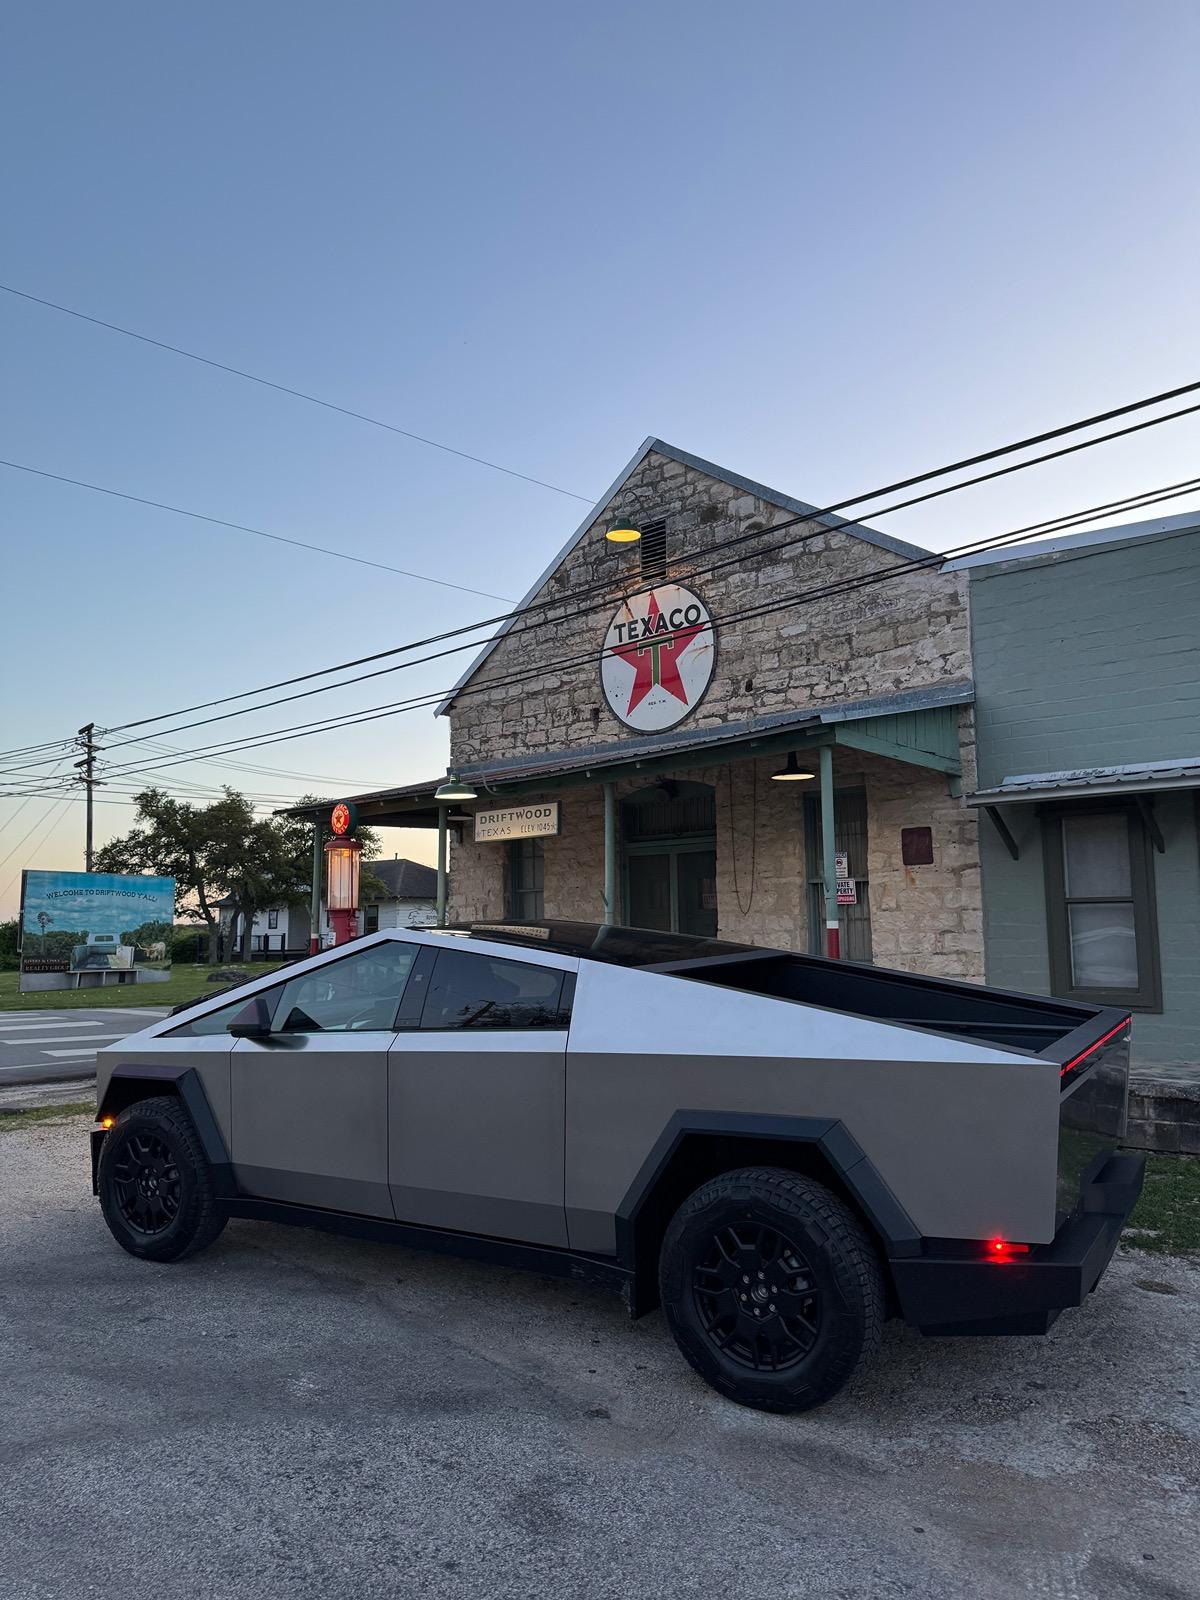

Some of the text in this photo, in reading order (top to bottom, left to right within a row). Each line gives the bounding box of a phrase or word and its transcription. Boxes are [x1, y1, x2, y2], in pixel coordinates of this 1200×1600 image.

[613, 604, 701, 643] TEXACO
[480, 809, 552, 824] DRIFTWOOD
[481, 827, 512, 837] TEXAS
[46, 889, 84, 899] WELCOME
[95, 889, 136, 898] DRIFTWOOD
